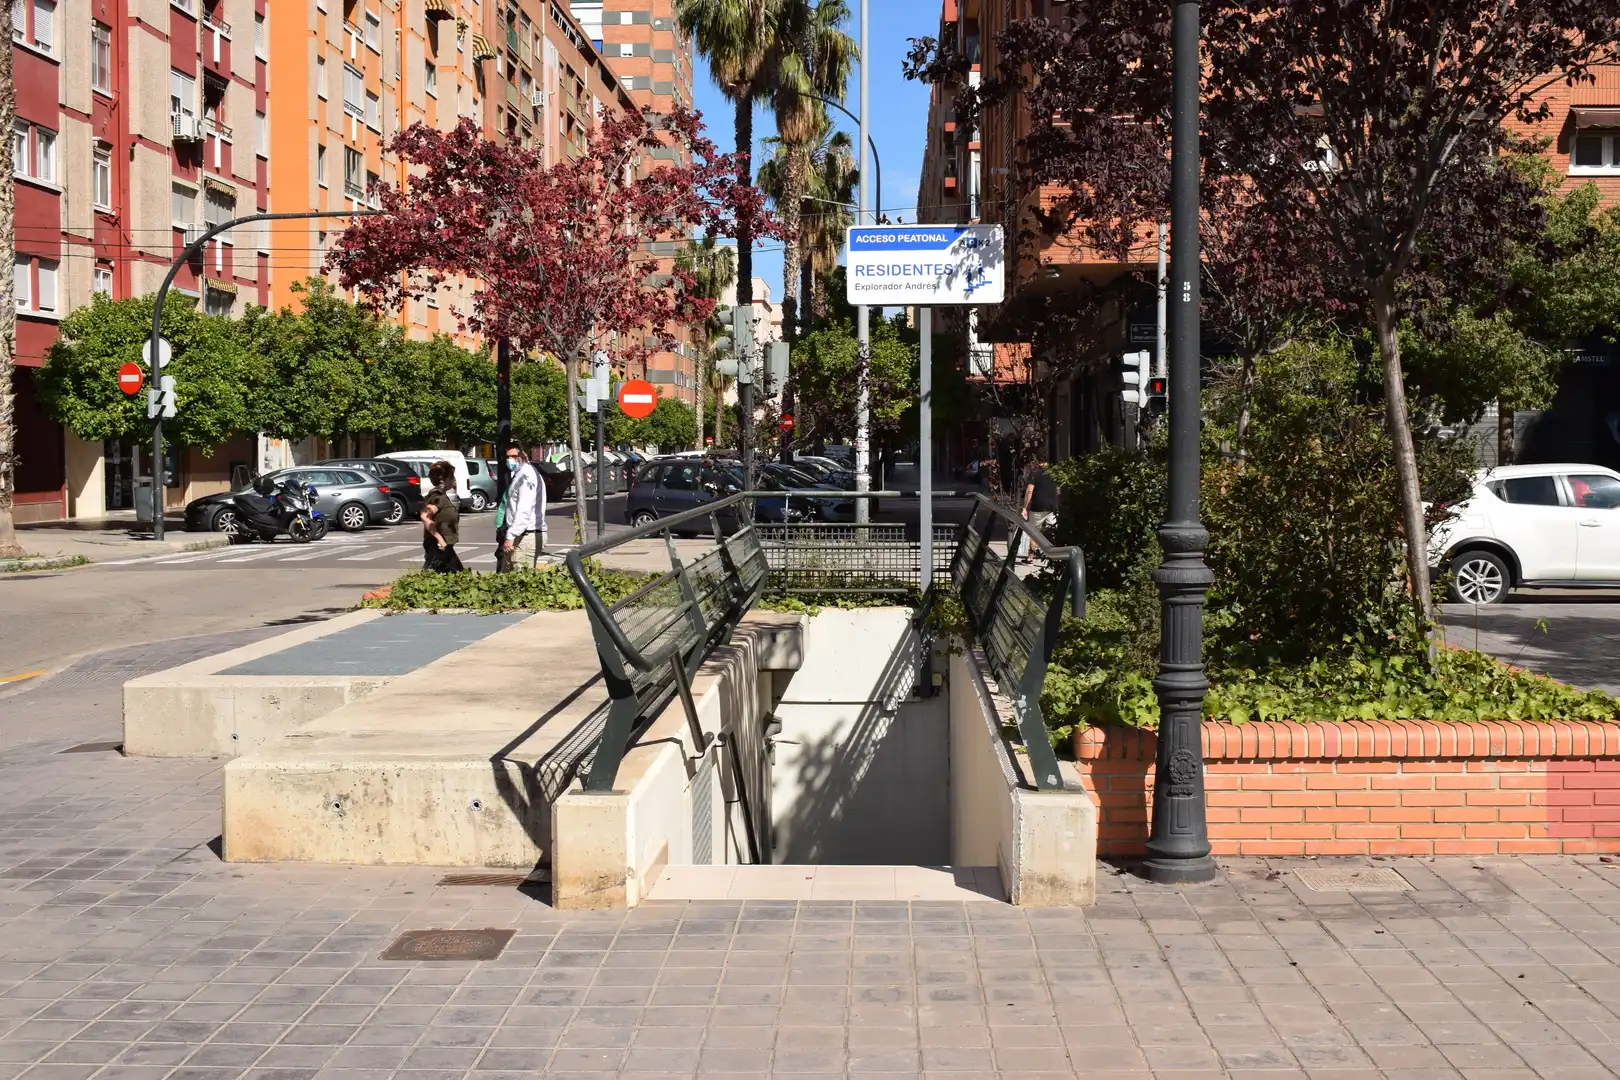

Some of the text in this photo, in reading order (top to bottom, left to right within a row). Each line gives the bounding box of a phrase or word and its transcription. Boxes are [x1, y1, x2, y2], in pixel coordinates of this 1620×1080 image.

[855, 233, 949, 244] ACCESO PEATONAL
[855, 263, 953, 277] RESIDENTES
[854, 282, 937, 292] Explorador Andrés
[1576, 355, 1605, 363] AMSTEL
